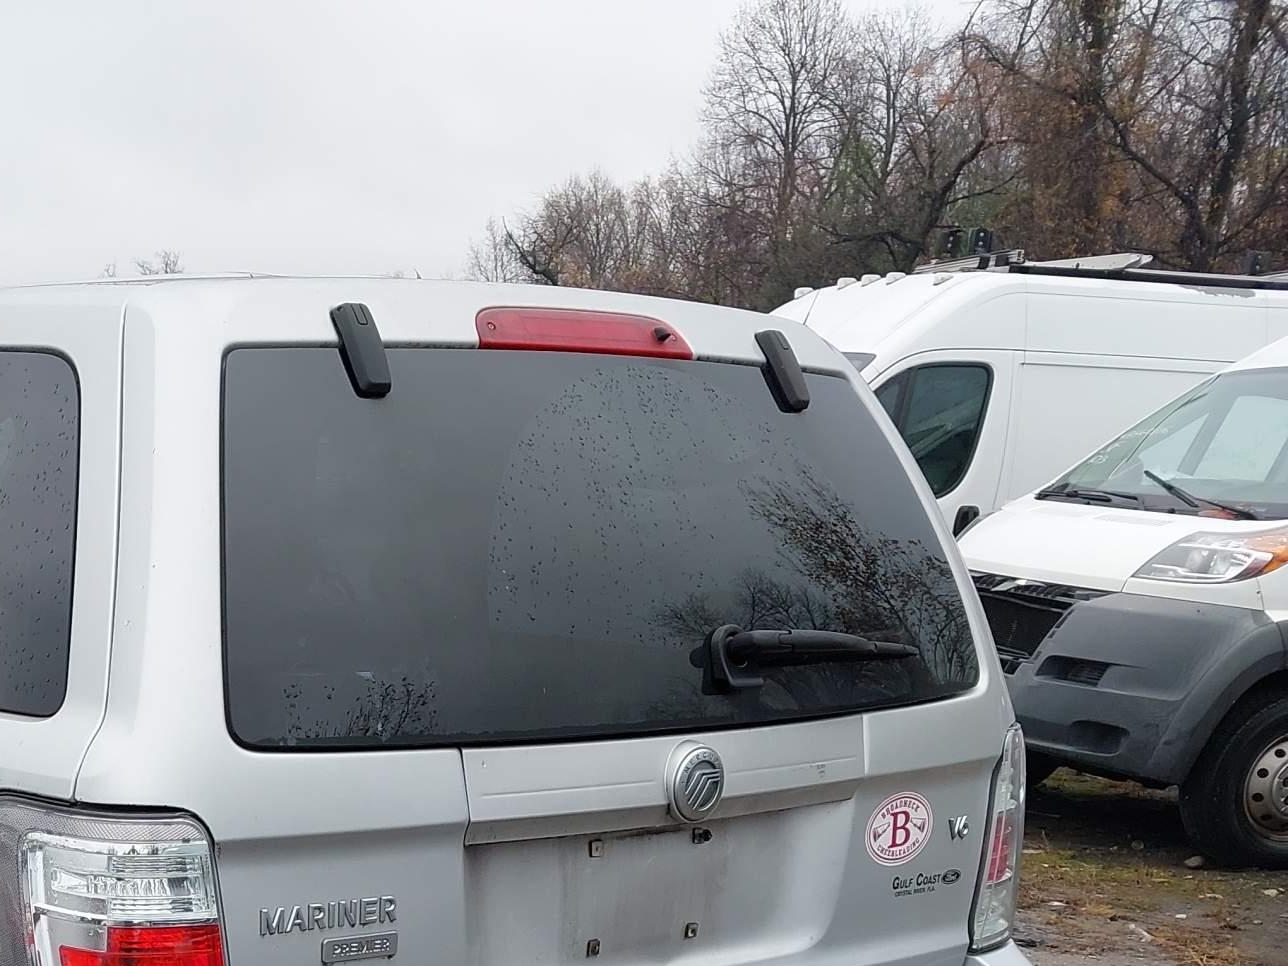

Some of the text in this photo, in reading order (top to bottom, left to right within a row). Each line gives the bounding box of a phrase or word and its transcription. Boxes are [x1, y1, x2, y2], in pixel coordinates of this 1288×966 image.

[887, 810, 911, 849] B
[948, 815, 969, 841] V6
[259, 895, 397, 937] MARINER
[332, 938, 391, 958] PREMIER
